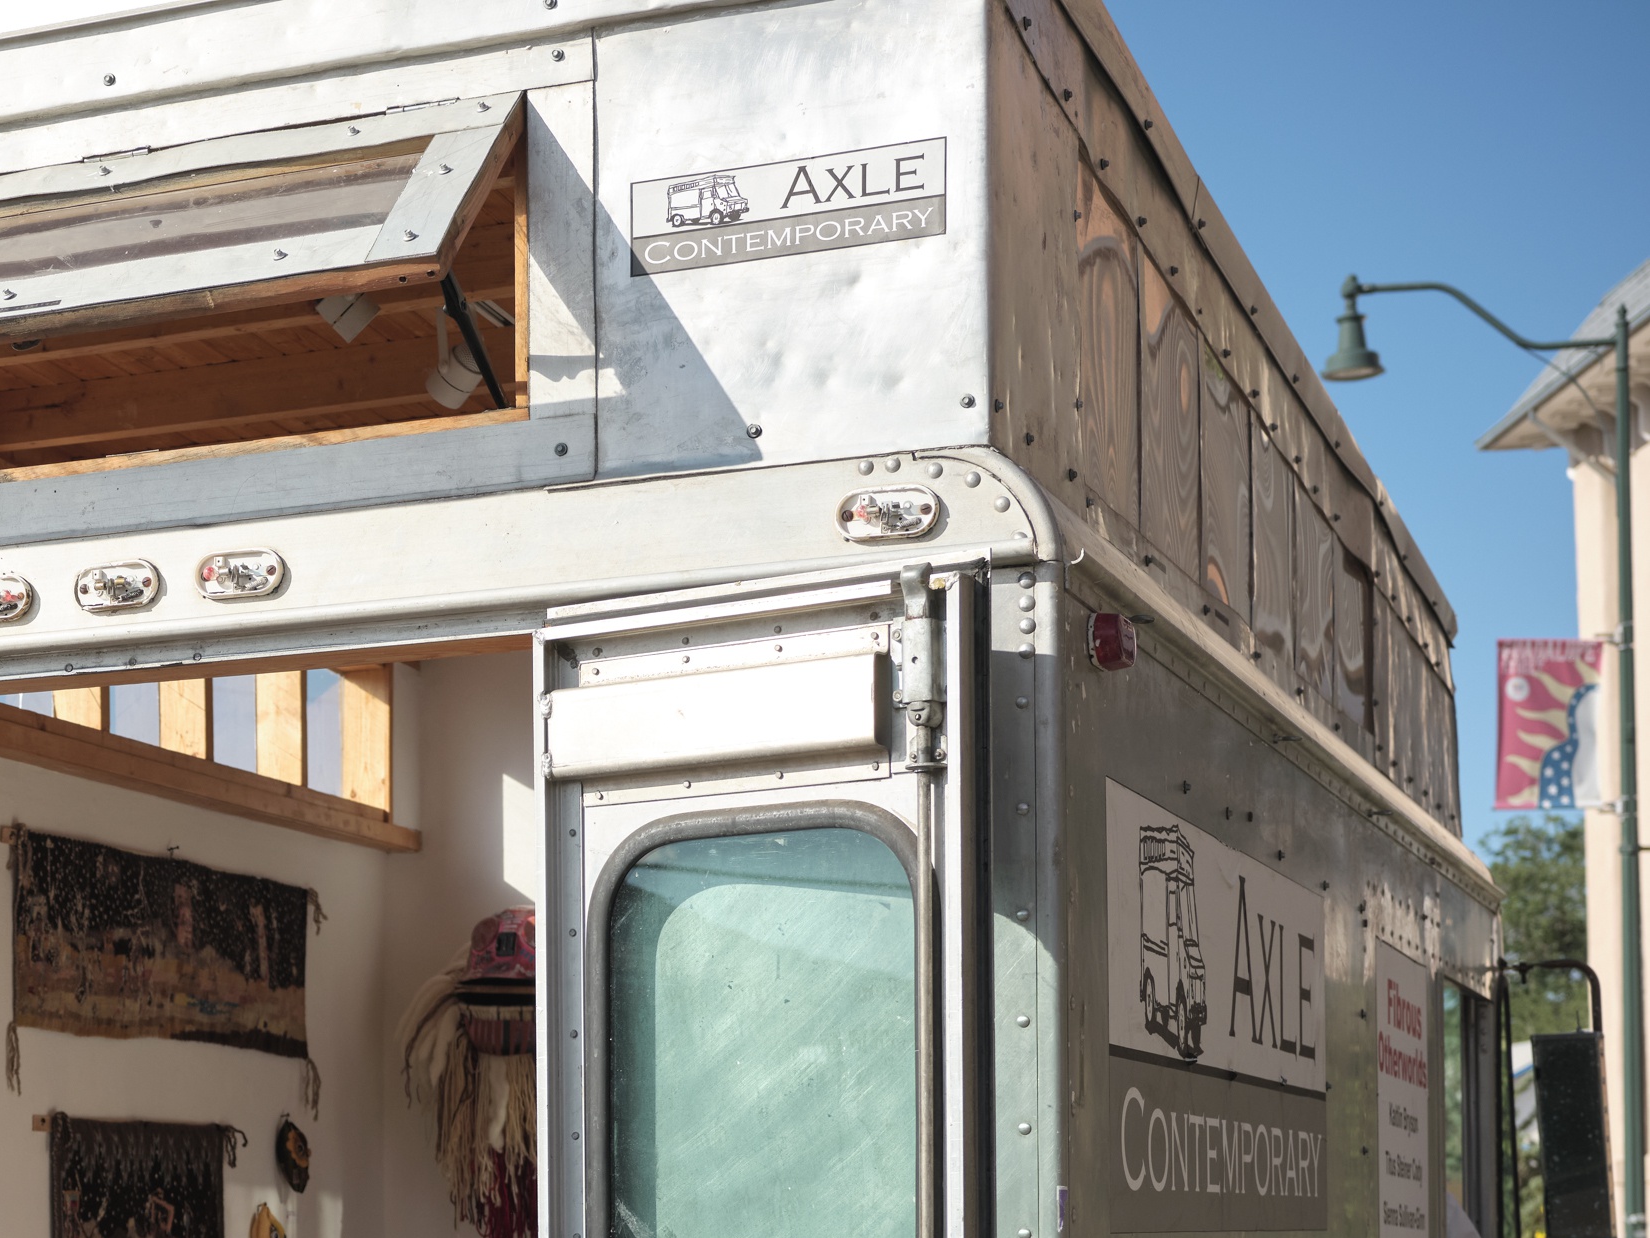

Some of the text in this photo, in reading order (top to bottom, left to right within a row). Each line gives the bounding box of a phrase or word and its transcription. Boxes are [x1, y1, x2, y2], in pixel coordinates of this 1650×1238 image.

[780, 153, 925, 209] AXLE
[644, 207, 934, 265] CONTEMPORARY
[1229, 874, 1316, 1060] AXLE
[1387, 978, 1422, 1040] Fibrous
[1378, 1031, 1428, 1089] Otherworlds
[1121, 1086, 1322, 1198] CONTEMPORARY
